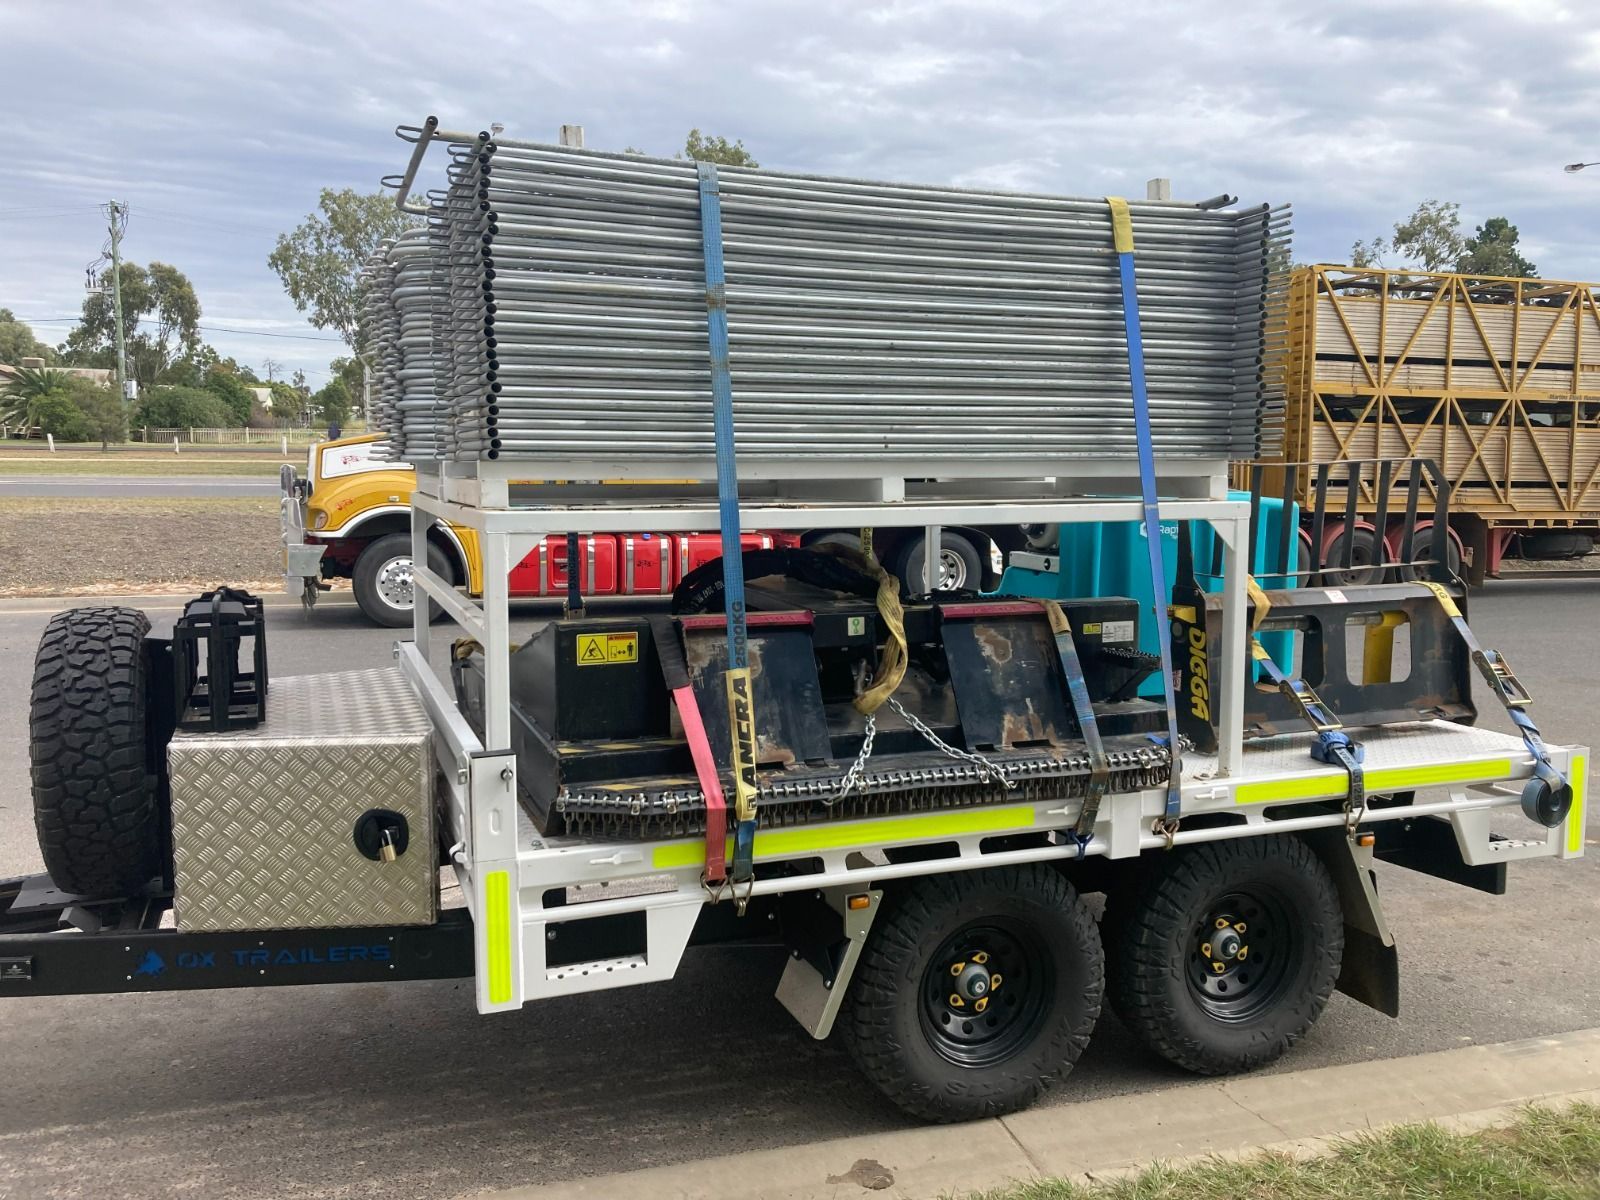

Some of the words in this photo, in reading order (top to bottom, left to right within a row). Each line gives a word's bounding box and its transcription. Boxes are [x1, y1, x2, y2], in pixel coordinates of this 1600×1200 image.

[732, 601, 745, 667] 2500KG
[1189, 627, 1210, 722] DIGGA
[176, 951, 216, 968] OX
[232, 944, 391, 966] TRAILERS
